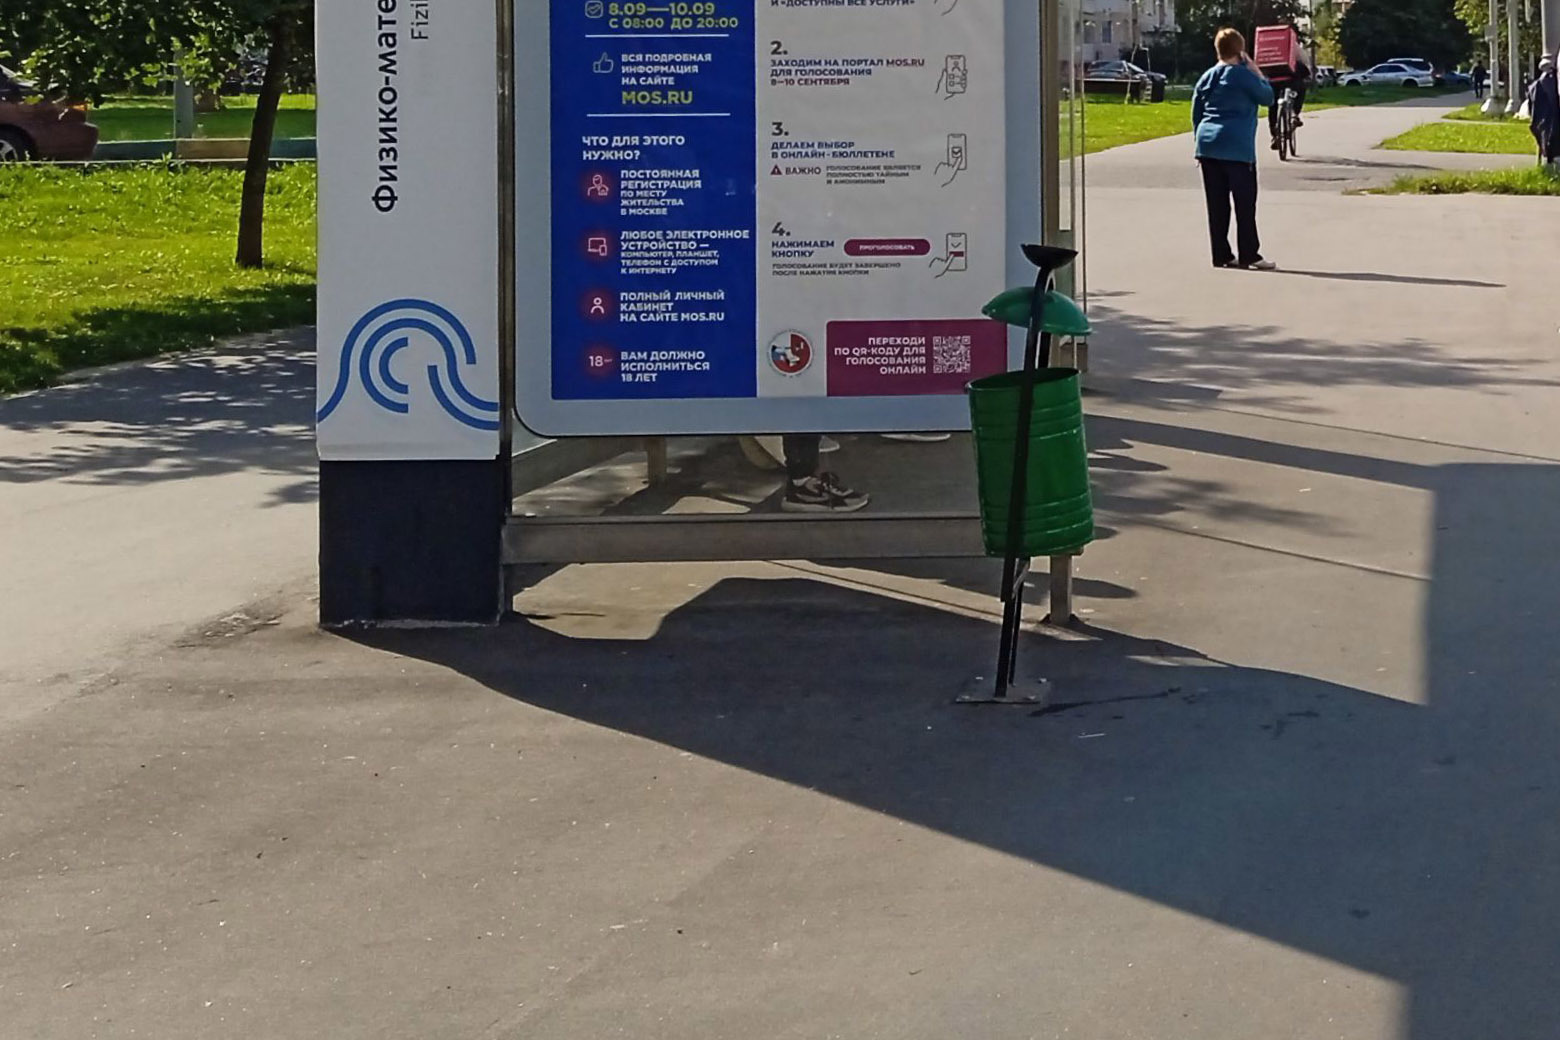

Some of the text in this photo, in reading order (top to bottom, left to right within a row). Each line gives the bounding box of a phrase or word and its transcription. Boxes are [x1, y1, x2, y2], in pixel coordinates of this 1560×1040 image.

[608, 17, 739, 30] С 08:00 ДО 20:00
[770, 40, 788, 55] 2.
[621, 53, 712, 63] ВСЯ ПОДРОБНАЯ
[770, 59, 822, 68] ЗАХОДИМ
[842, 59, 884, 67] ПОРТАЛ
[886, 58, 925, 67] MOS.RU
[621, 65, 699, 74] ИНФОРМАЦИЯ
[770, 68, 872, 77] ДЛЯ ГОЛОСОВАНИЯ
[621, 75, 675, 85] НА САЙТЕ
[797, 78, 850, 86] СЕНТЯБРЯ
[621, 91, 693, 104] MOS.RU
[771, 122, 789, 136] 3.
[582, 135, 685, 148] ЧТО ДЛЯ ЭТОГО
[770, 141, 855, 150] ДЕЛАЕМ ВЫБОР
[582, 150, 641, 160] НУЖНО?
[771, 151, 778, 159] В
[621, 169, 700, 178] ПОСТОЯННАЯ
[785, 167, 822, 176] ВАЖНО
[621, 180, 702, 190] РЕГИСТРАЦИЯ
[621, 190, 667, 198] ПО МЕСТУ
[620, 198, 684, 206] ЖИТЕЛЬСТВА
[771, 221, 791, 237] 4.
[620, 230, 750, 240] ЛЮБОЕ ЭЛЕКТРОННОЕ
[620, 240, 697, 250] УСТРОЙСТВО
[771, 240, 835, 249] НАЖИМАЕМ
[771, 250, 814, 259] КНОПКУ
[670, 259, 719, 267] ДОСТУПОМ
[620, 289, 725, 301] ПОЛНЫЙ ЛИЧНЫЙ
[620, 303, 674, 311] КАБИНЕТ
[620, 311, 725, 322] НА САЙТЕ MOS.RU
[868, 337, 926, 346] ПЕРЕХОДИ
[621, 351, 706, 361] ВАМ ДОЛЖНО
[834, 347, 926, 356] ПО QR-КОДУ ДЛЯ
[846, 357, 926, 365] ГОЛОСОВАНИЯ
[621, 362, 710, 371] ИСПОЛНИТЬСЯ
[880, 364, 927, 374] ОНЛАЙН
[621, 373, 658, 382] 18 ЛЕТ
